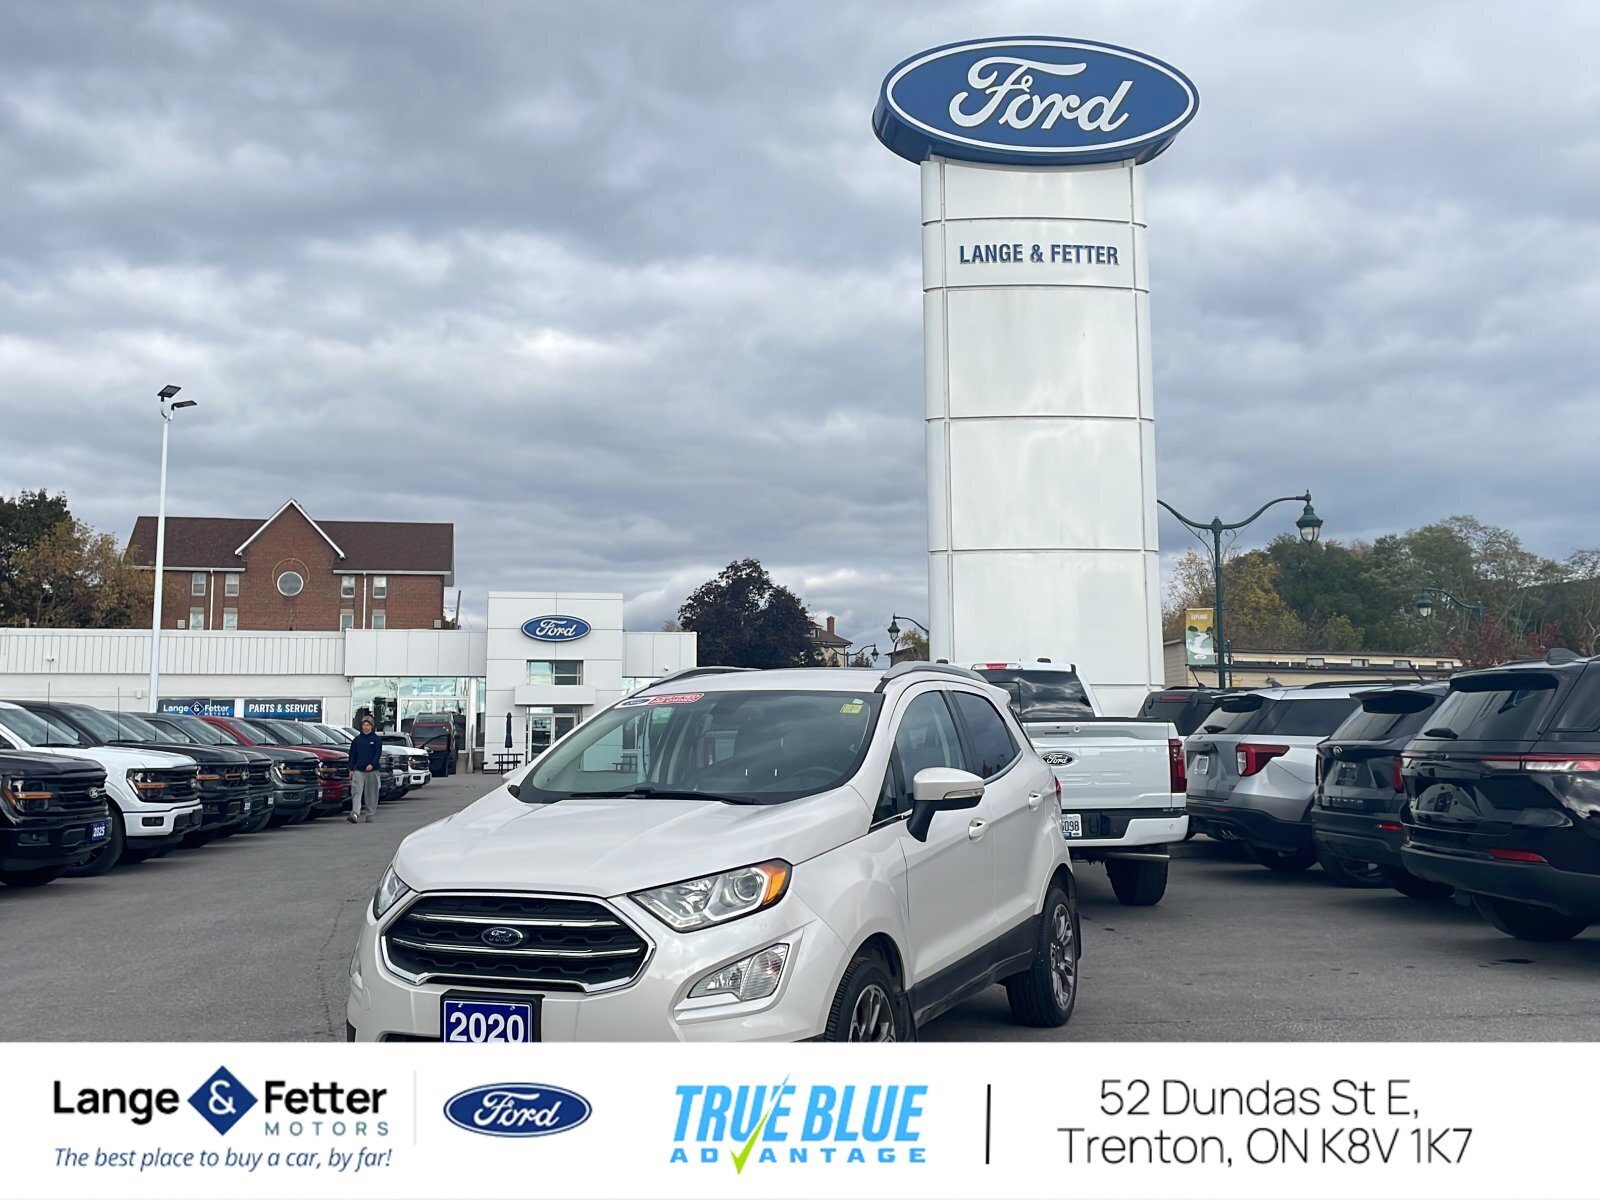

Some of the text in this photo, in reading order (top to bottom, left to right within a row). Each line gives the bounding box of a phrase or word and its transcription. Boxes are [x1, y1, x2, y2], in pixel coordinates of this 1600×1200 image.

[949, 56, 1134, 132] Ford
[959, 243, 1120, 266] LANGE & FETTER
[535, 619, 578, 637] Ford
[163, 704, 230, 714] Lange & Fetter
[249, 703, 319, 713] PARTS & SERVICE
[1046, 754, 1069, 765] Ford
[488, 929, 512, 941] Ford
[449, 1011, 525, 1043] 2020
